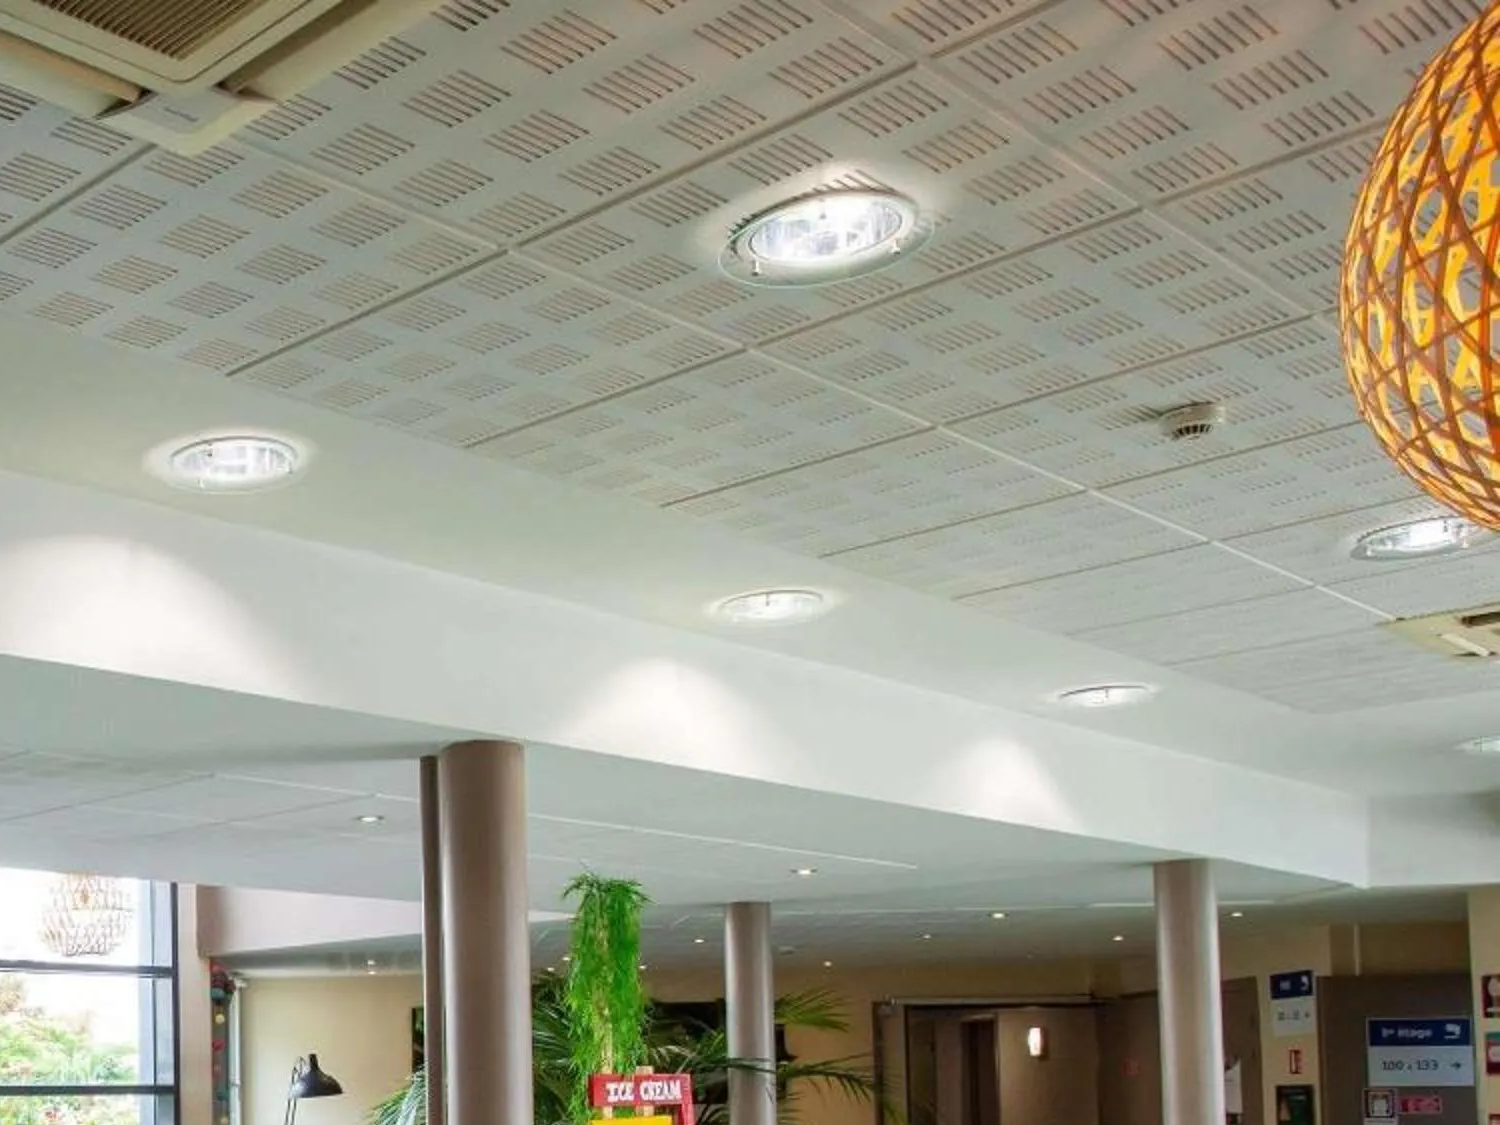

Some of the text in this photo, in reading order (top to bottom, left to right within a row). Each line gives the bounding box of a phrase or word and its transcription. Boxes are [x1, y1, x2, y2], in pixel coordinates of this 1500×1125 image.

[1417, 1059, 1439, 1071] 133
[605, 1080, 682, 1102] ICE CREAM
